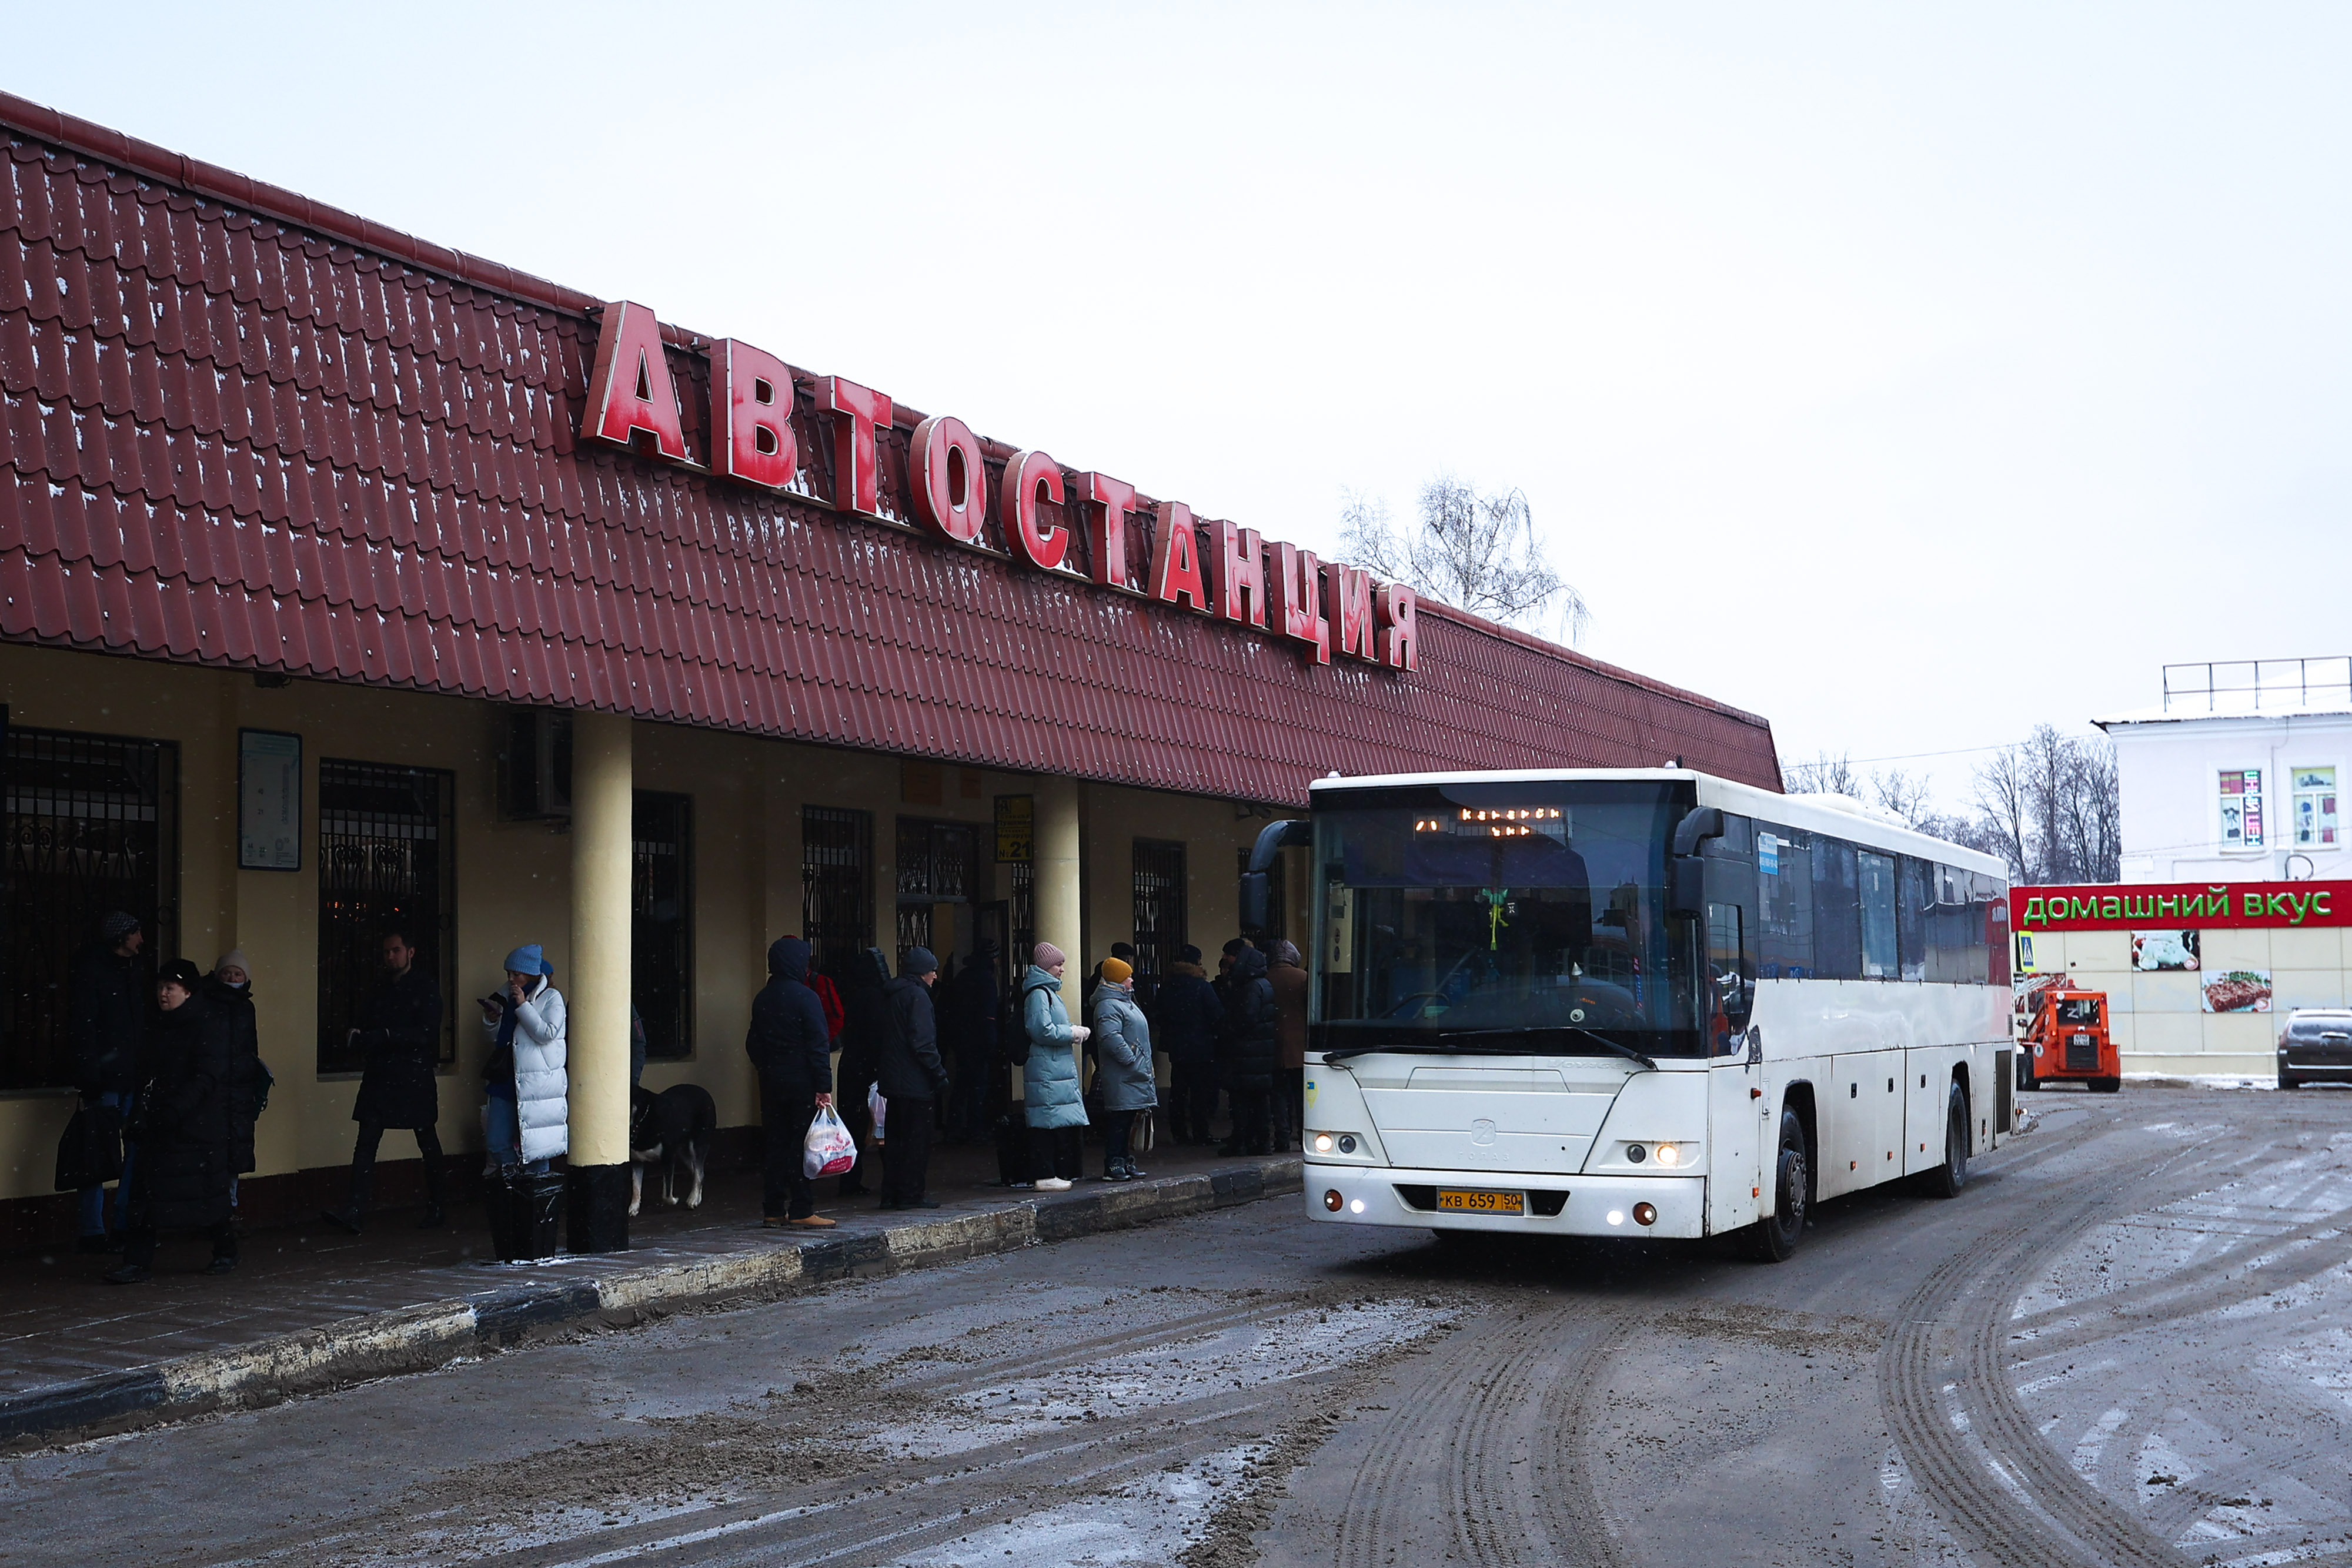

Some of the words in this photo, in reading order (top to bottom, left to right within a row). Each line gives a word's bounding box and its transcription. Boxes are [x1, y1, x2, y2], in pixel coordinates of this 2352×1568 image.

[581, 300, 1418, 672] АВТОСТАНЦИЯ
[2023, 885, 2230, 926] домашний
[2243, 891, 2331, 925] вкус
[1445, 1195, 1462, 1207] КВ
[1468, 1193, 1495, 1208] 659
[1504, 1194, 1518, 1206] 50
